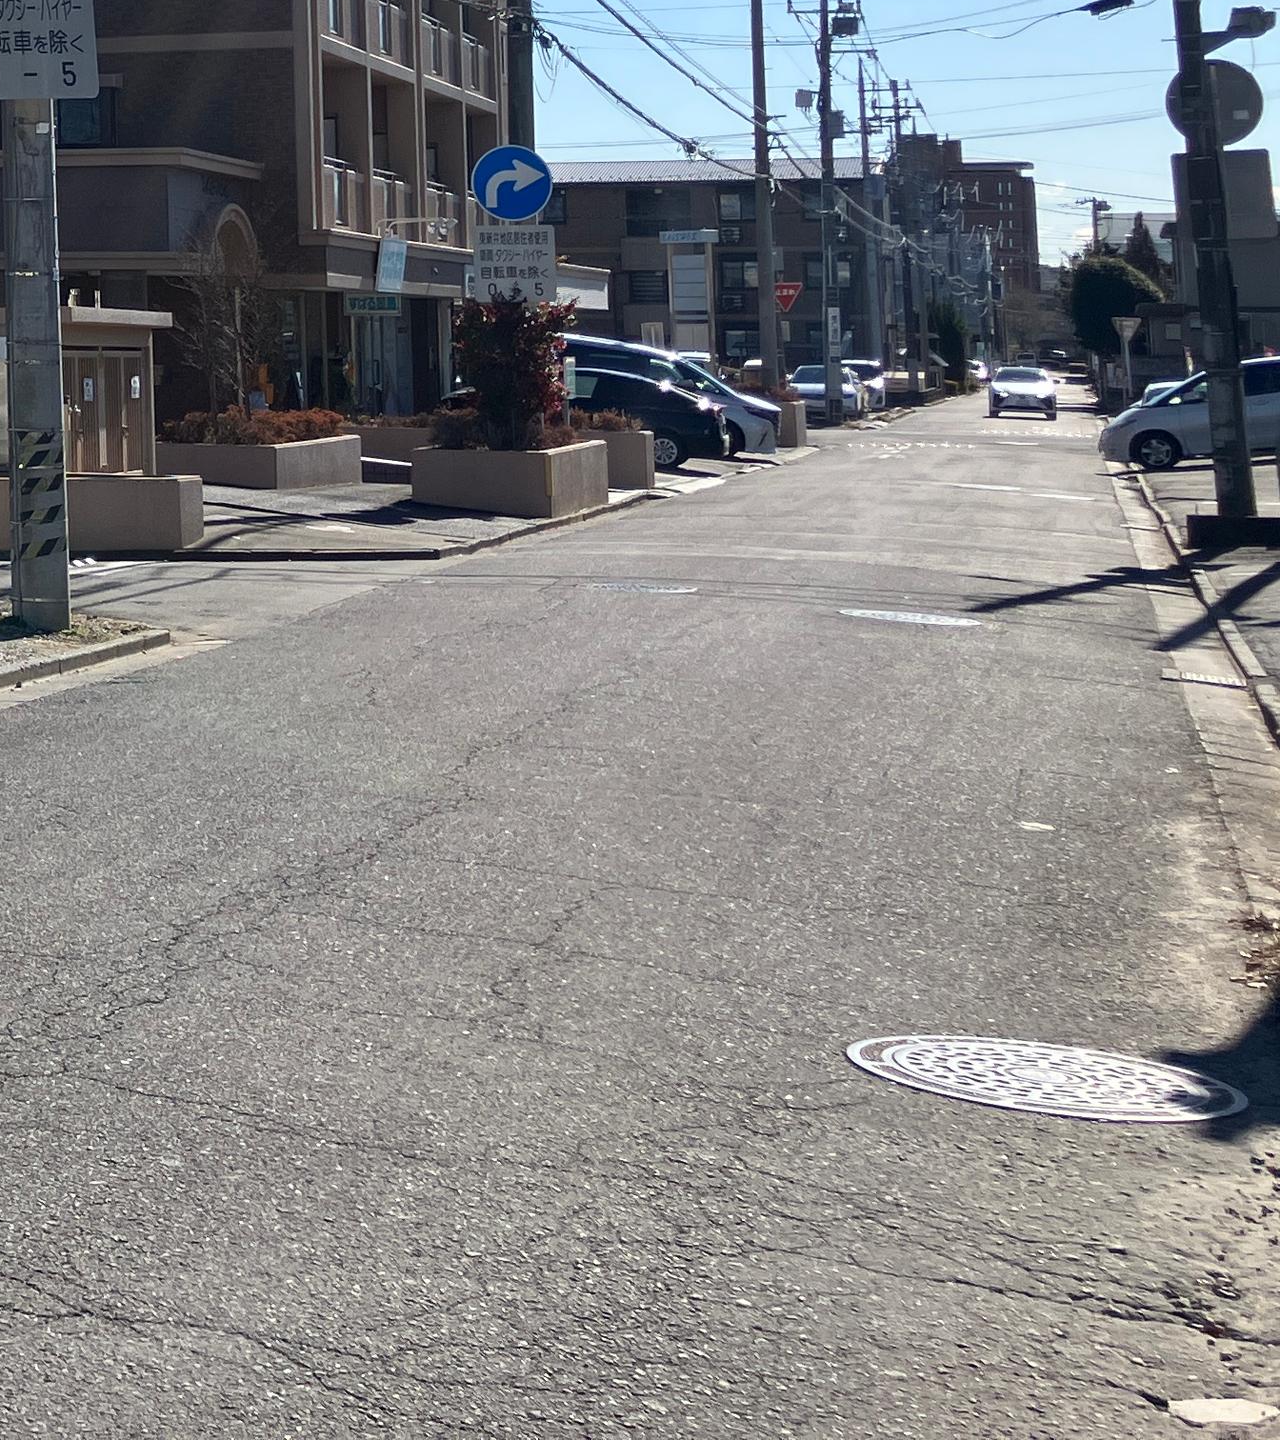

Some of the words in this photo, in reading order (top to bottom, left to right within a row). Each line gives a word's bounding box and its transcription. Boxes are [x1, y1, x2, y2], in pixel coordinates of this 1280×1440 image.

[61, 61, 76, 86] 5
[481, 266, 548, 279] 自転車を除く
[534, 283, 543, 296] 5
